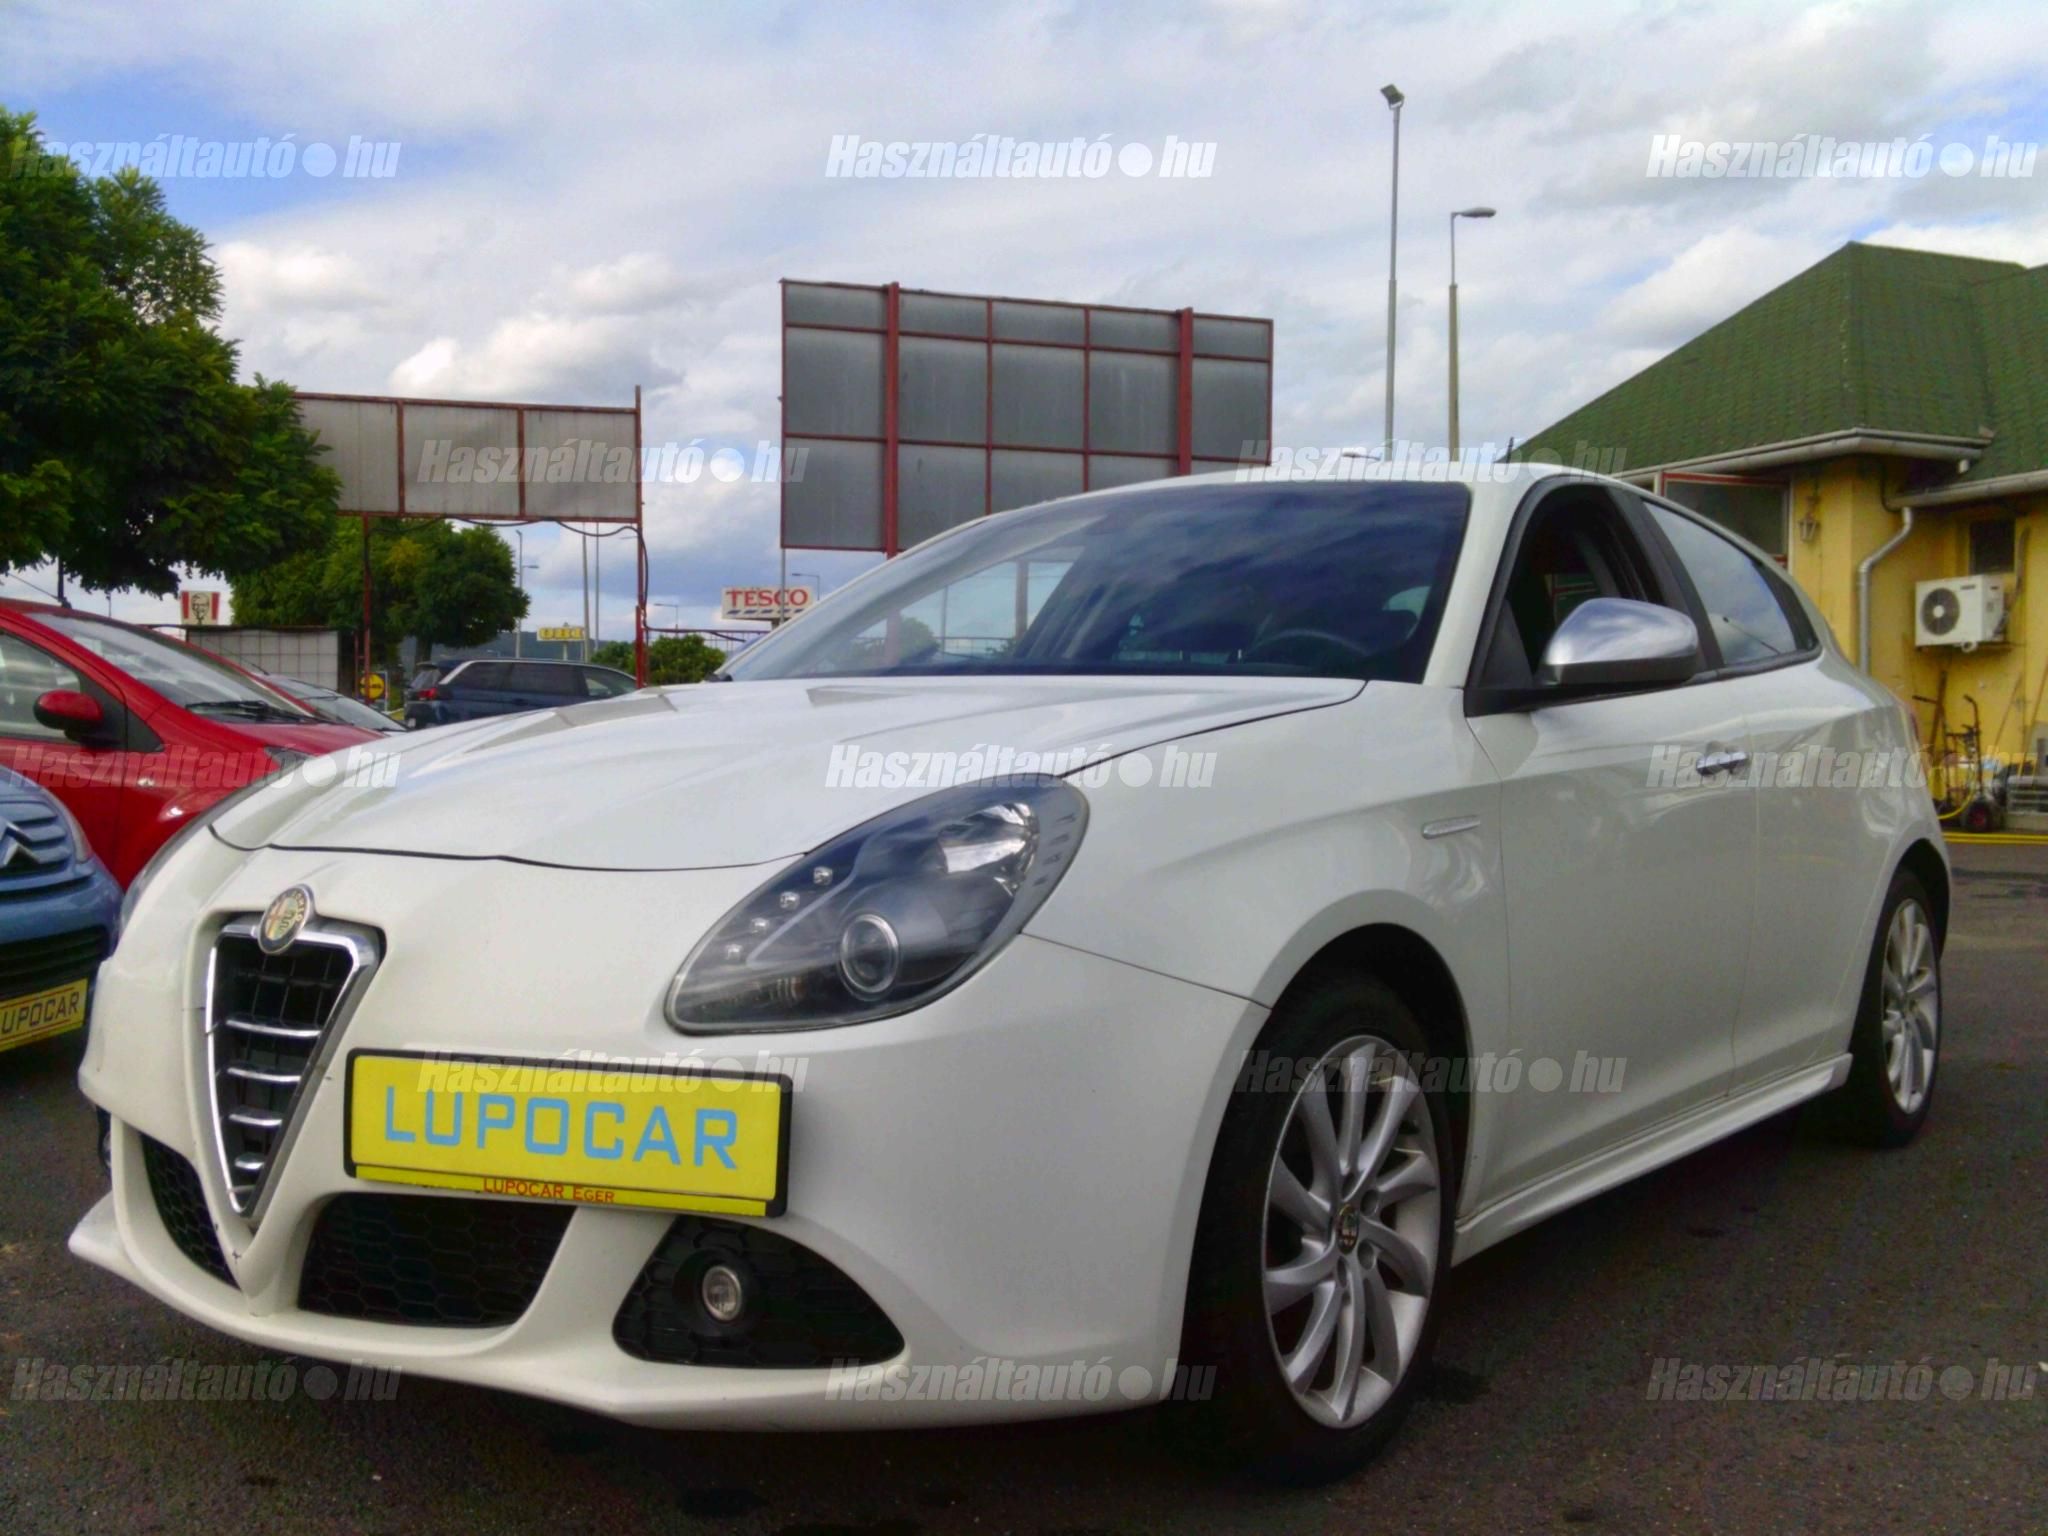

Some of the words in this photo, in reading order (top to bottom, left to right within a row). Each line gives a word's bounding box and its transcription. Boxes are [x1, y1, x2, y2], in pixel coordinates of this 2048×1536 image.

[726, 588, 808, 607] TESCO
[385, 1085, 738, 1170] LUPOCAR
[483, 1177, 564, 1198] LUPOCAR
[573, 1184, 615, 1203] EGER
